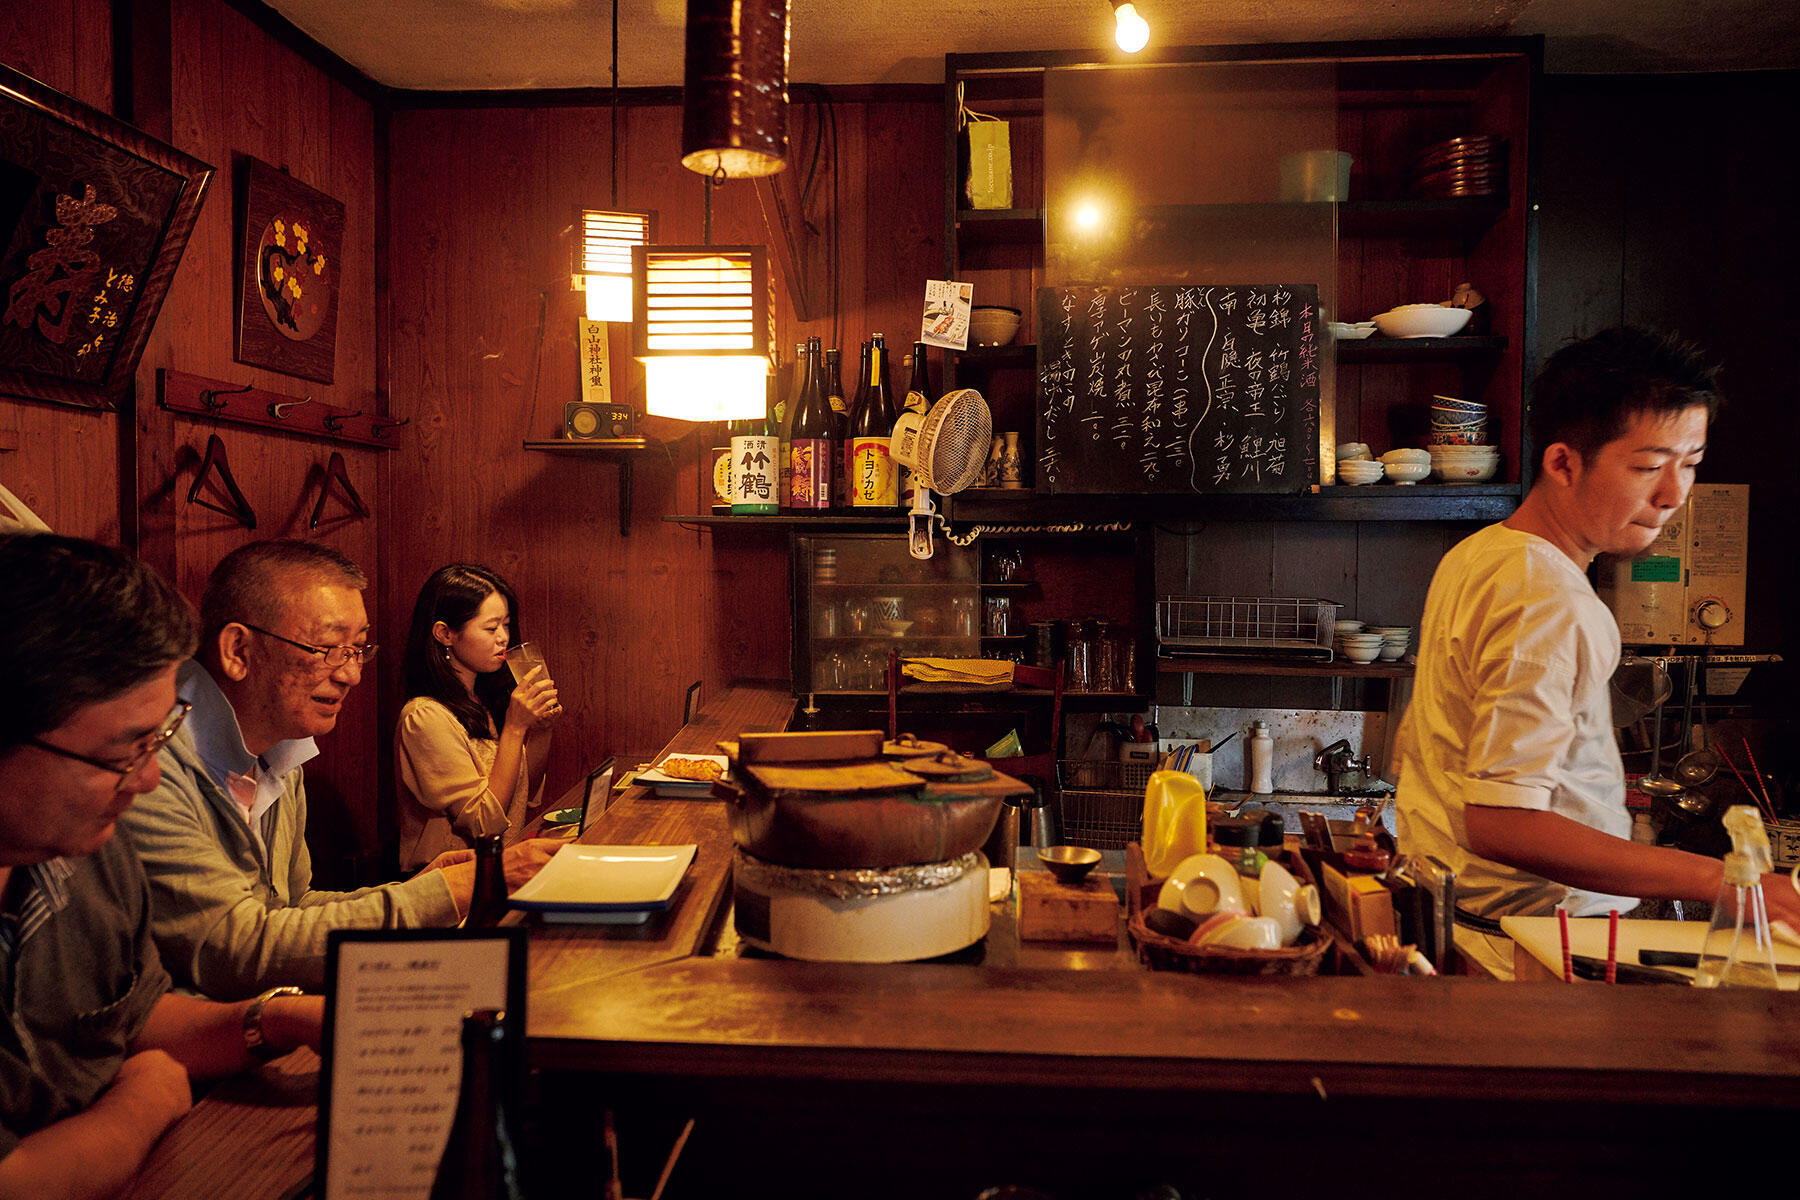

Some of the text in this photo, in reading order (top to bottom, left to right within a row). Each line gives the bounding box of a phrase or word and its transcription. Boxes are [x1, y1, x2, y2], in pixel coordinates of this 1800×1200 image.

[738, 451, 773, 499] 竹鶴
[863, 449, 875, 501] トヨノカゼ
